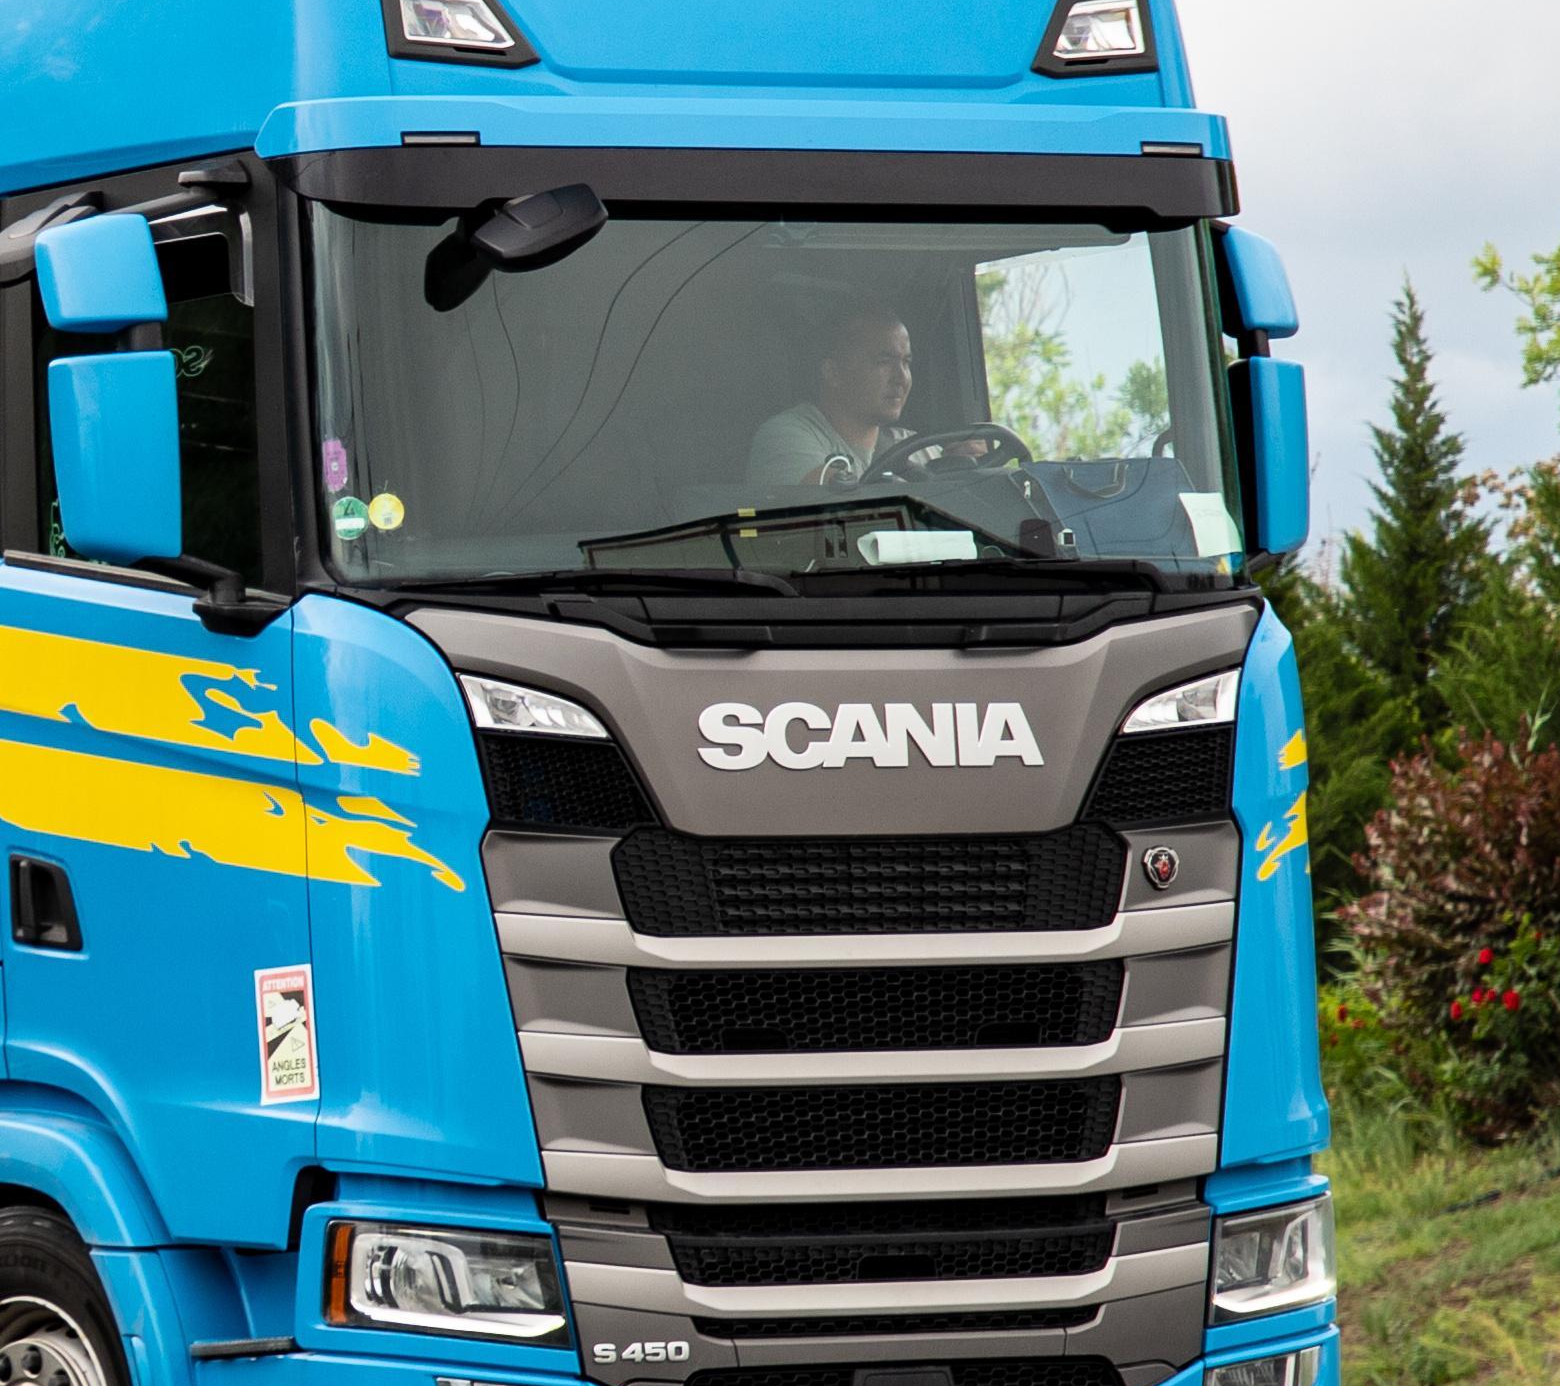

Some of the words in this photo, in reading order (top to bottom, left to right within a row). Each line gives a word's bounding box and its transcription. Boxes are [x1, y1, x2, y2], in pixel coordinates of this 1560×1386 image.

[696, 701, 1046, 771] SCANIA
[271, 1057, 307, 1073] ANGLES
[274, 1072, 306, 1086] MORTS
[593, 1342, 617, 1364] S
[621, 1340, 690, 1363] 450
